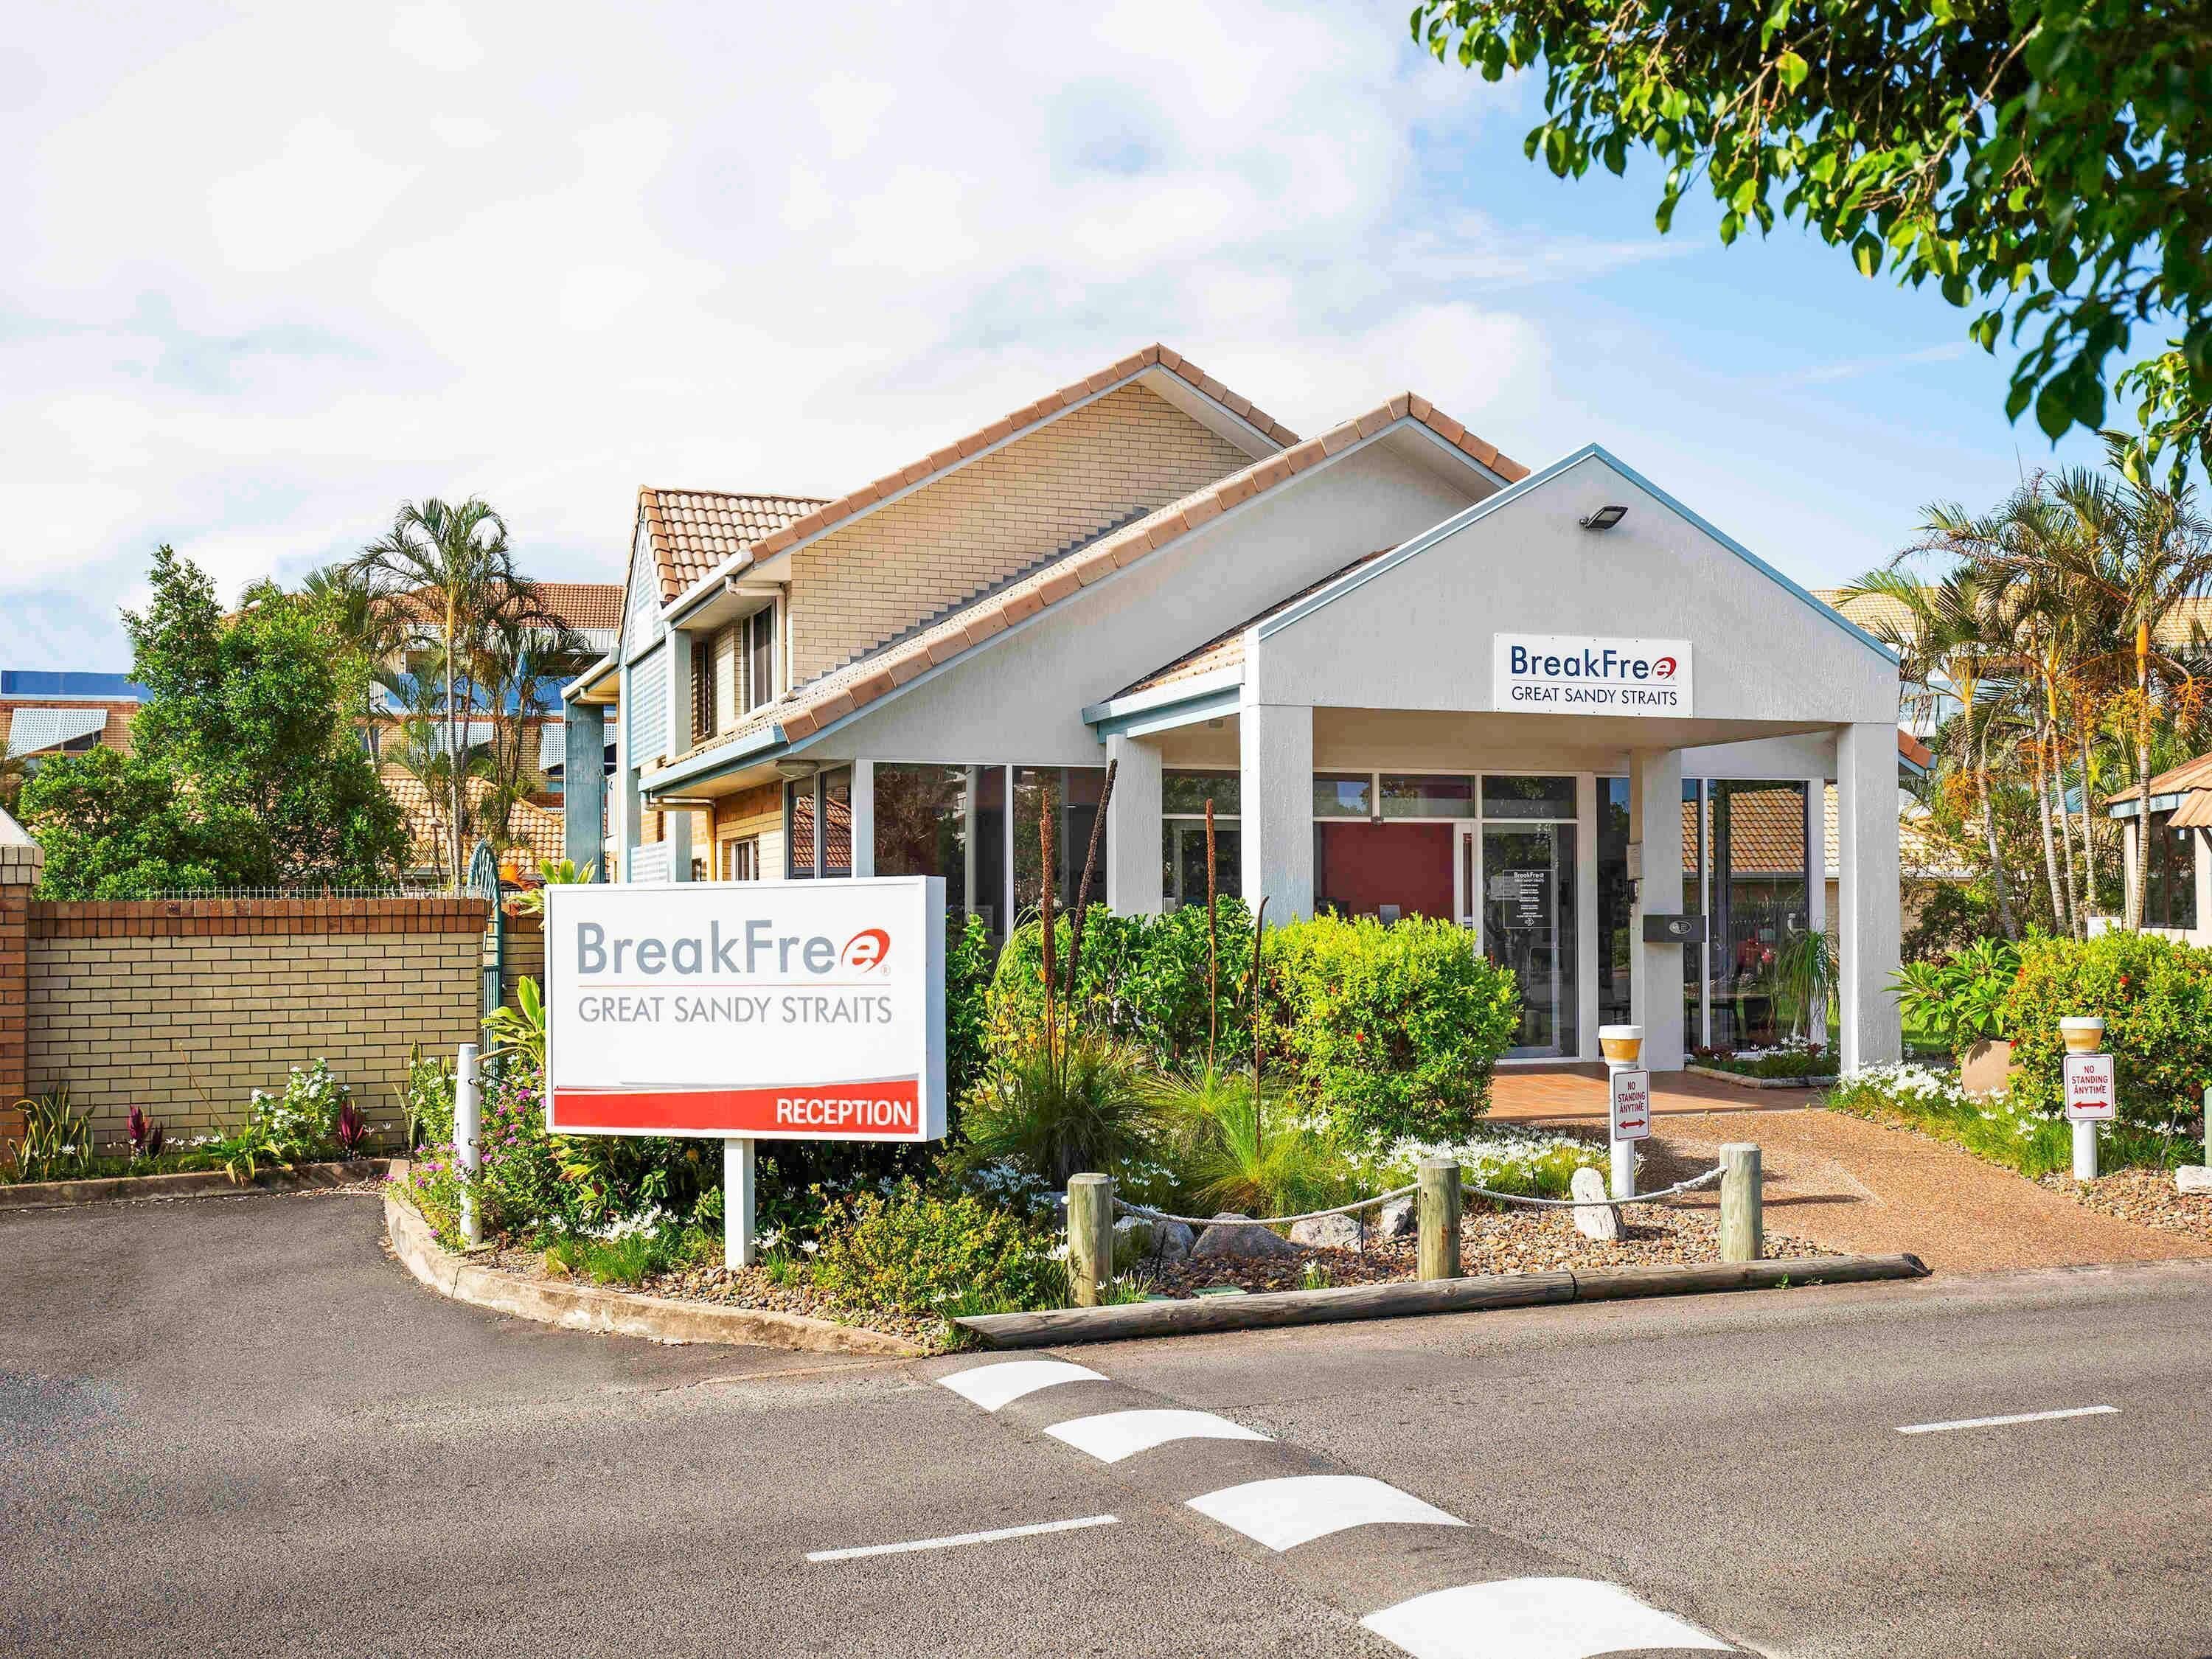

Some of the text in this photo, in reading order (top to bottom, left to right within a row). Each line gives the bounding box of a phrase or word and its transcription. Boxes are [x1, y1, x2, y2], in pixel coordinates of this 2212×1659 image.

[1512, 646, 1677, 679] BreakFree
[1512, 686, 1677, 706] GREAT SANDY STRAITS
[577, 920, 891, 975] BreakFree
[578, 996, 892, 1024] GREAT SANDY STRAITS
[2084, 1065, 2095, 1074] NO
[2072, 1076, 2108, 1084] STANDING
[1628, 1081, 1635, 1091] NO
[2074, 1085, 2106, 1094] ANYTIME
[1618, 1092, 1645, 1102] STANDING
[776, 1099, 912, 1126] RECEPTION
[1620, 1103, 1644, 1113] ANYTIME
